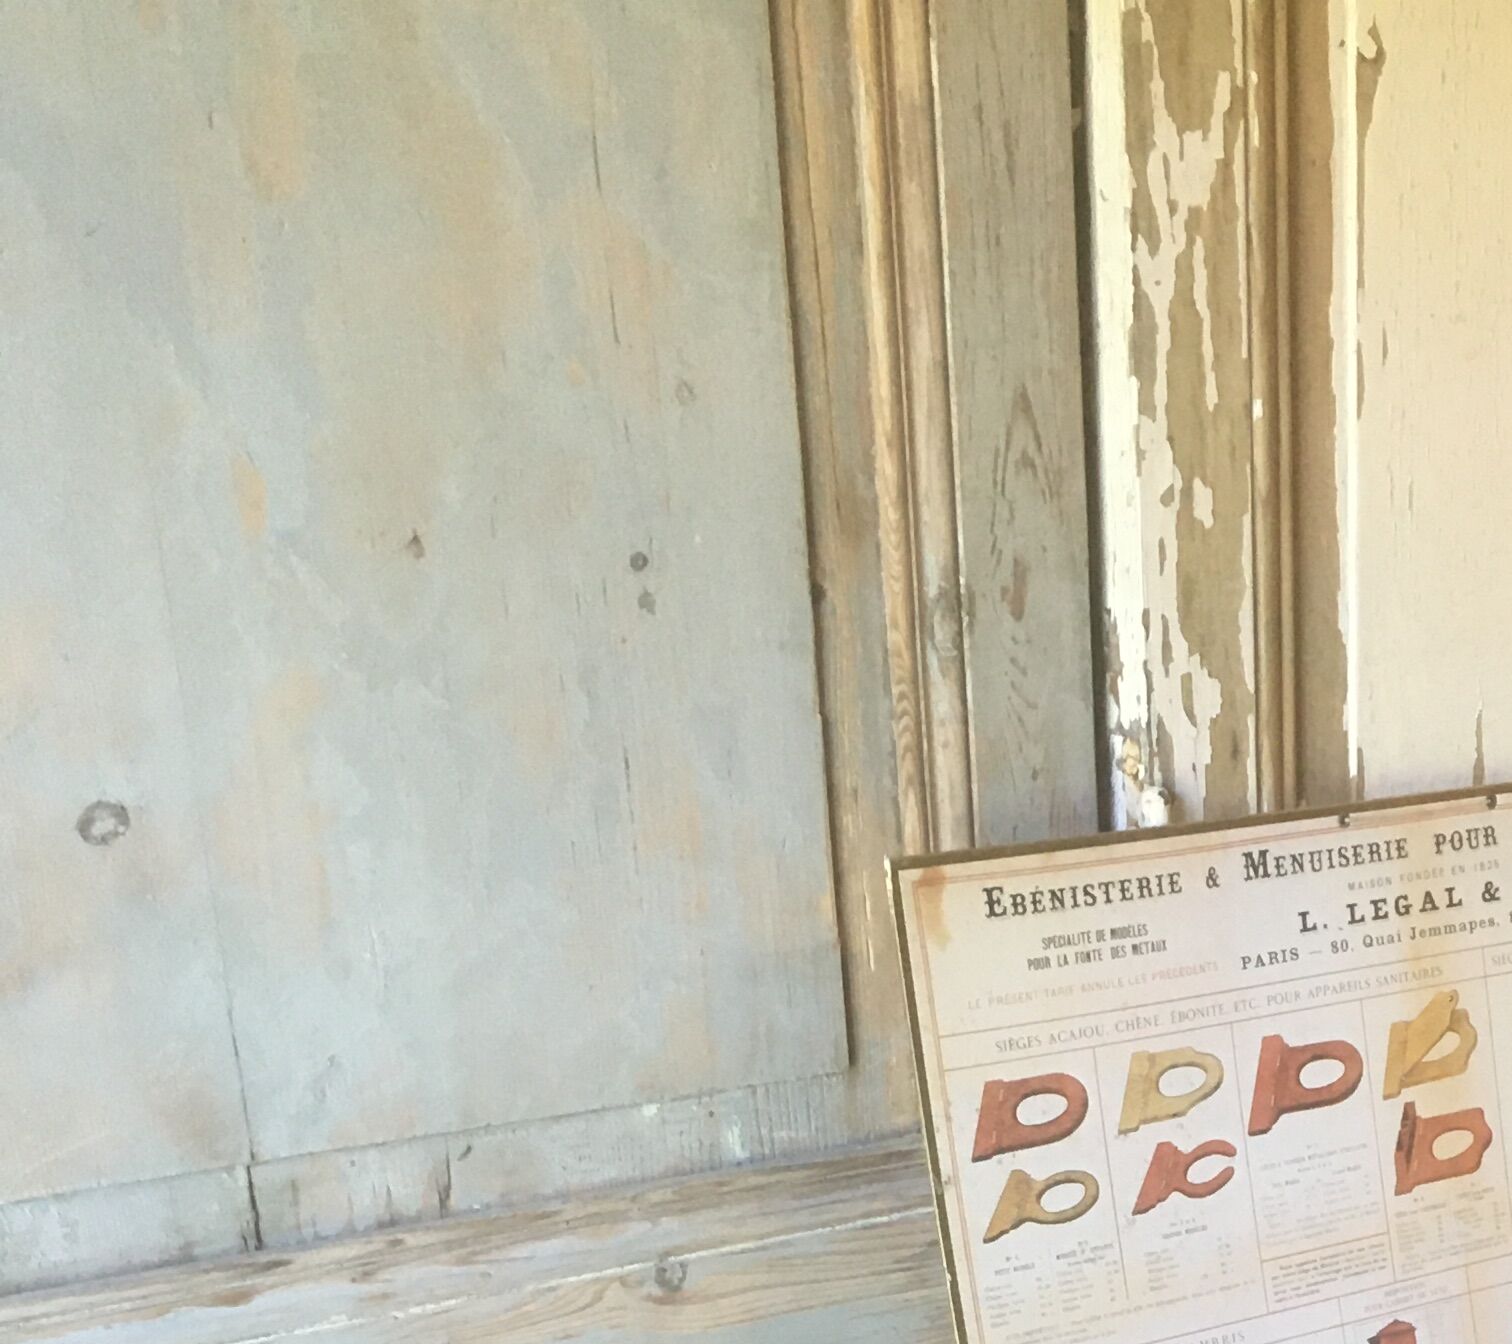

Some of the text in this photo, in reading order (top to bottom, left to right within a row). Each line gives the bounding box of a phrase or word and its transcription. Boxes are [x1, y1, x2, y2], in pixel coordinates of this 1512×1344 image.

[982, 872, 1183, 918] EBÉNISTERIE
[1205, 866, 1220, 889] &
[1242, 837, 1409, 881] MENUISERIE
[1434, 824, 1499, 855] POUR
[1348, 876, 1393, 891] MAISON
[1451, 863, 1466, 877] EN
[1298, 910, 1329, 934] L.
[1346, 886, 1463, 926] LEGAL
[1481, 880, 1501, 903] &
[1096, 928, 1107, 943] DE
[1241, 946, 1301, 970] PARIS
[1362, 932, 1402, 949] Quai
[1027, 955, 1051, 971] POUR
[1057, 952, 1070, 967] LA
[1075, 948, 1103, 964] FONTE
[1110, 944, 1127, 959] DES
[968, 996, 983, 1010] LE
[1044, 983, 1075, 999] TARIF
[1081, 976, 1124, 993] ANNULE
[1266, 990, 1302, 1007] POUR
[1308, 978, 1371, 999] APPAREILS
[1376, 966, 1444, 987] SANITAIRES
